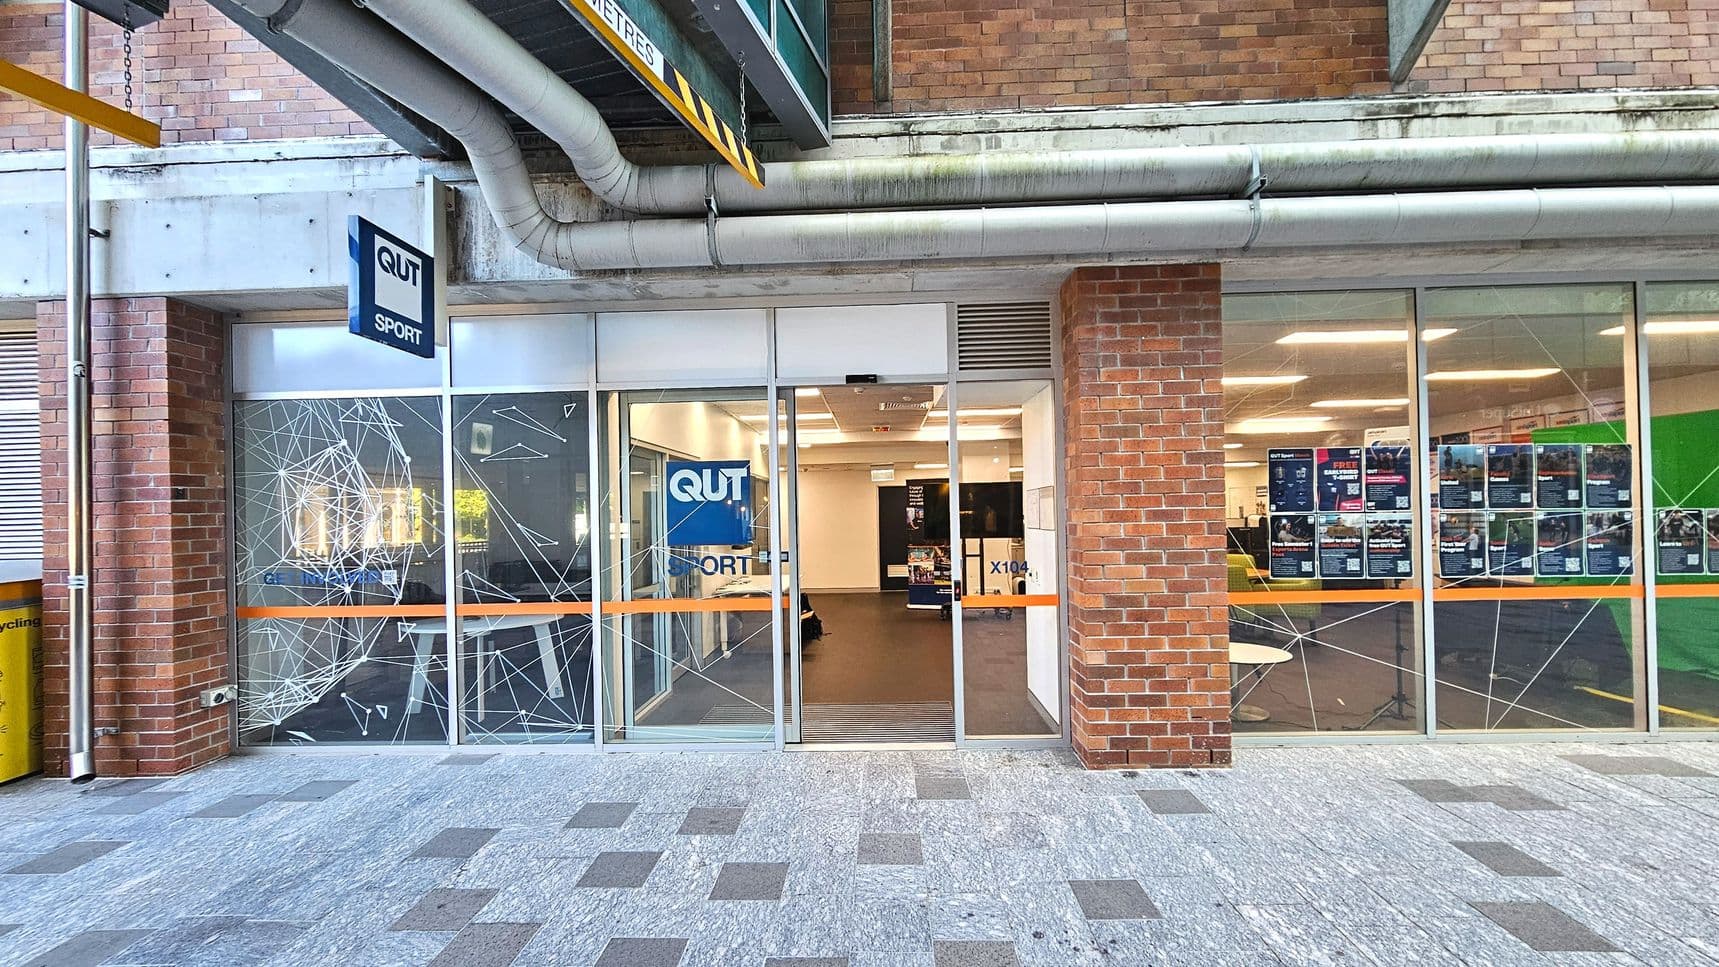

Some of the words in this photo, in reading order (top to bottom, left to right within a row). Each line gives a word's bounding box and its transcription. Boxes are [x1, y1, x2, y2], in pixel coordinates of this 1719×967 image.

[377, 245, 420, 287] QUT
[374, 313, 423, 345] SPORT
[669, 468, 748, 502] QUT
[668, 555, 752, 577] SPORT
[990, 561, 1029, 575] X104
